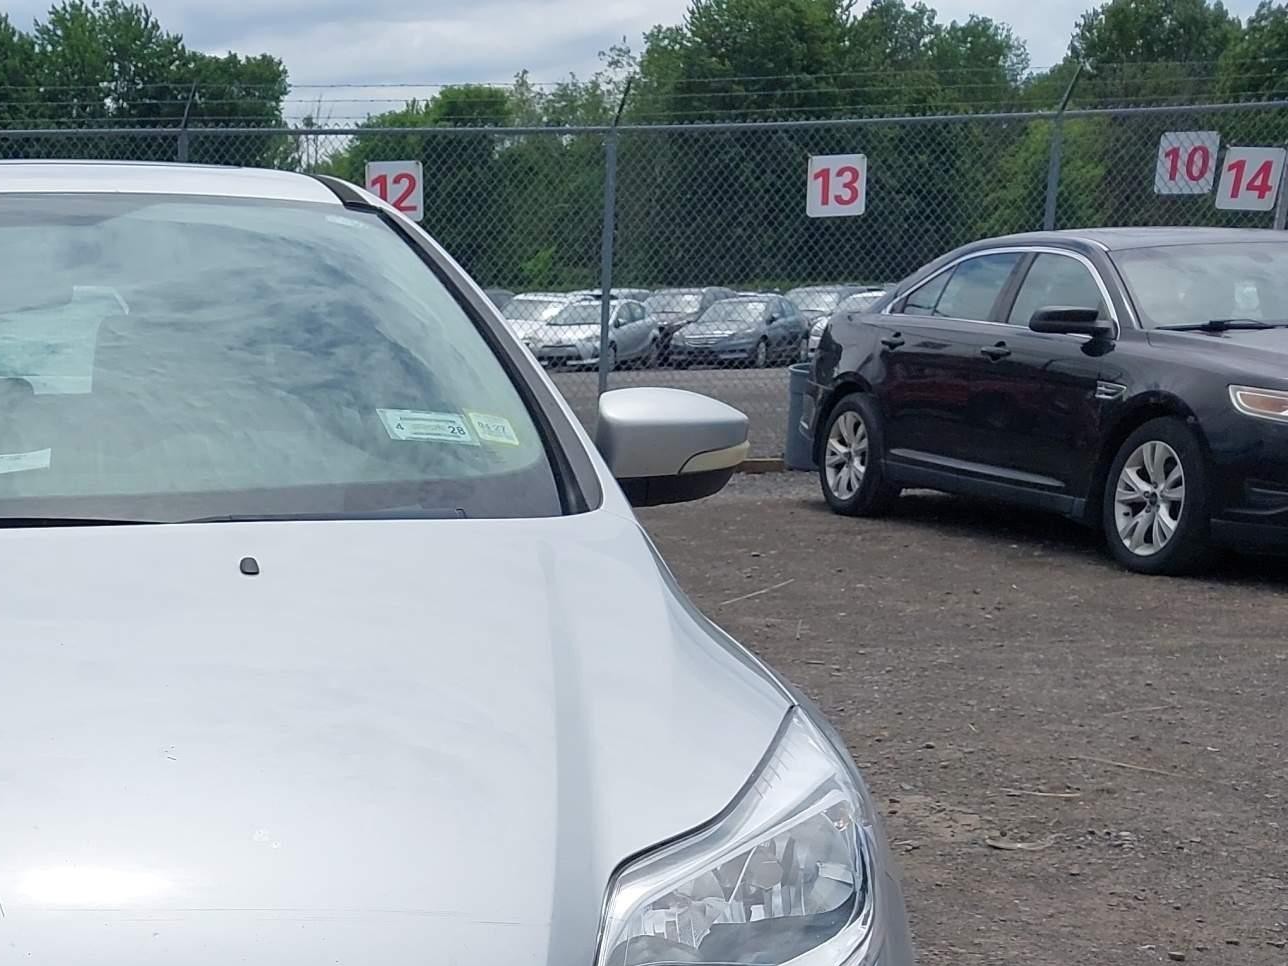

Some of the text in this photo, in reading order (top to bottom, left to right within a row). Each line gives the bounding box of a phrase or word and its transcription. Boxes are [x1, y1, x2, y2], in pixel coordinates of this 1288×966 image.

[1164, 144, 1210, 182] 10
[1227, 159, 1274, 200] 14
[371, 173, 417, 211] 12
[813, 166, 860, 206] 13
[447, 425, 467, 436] 28
